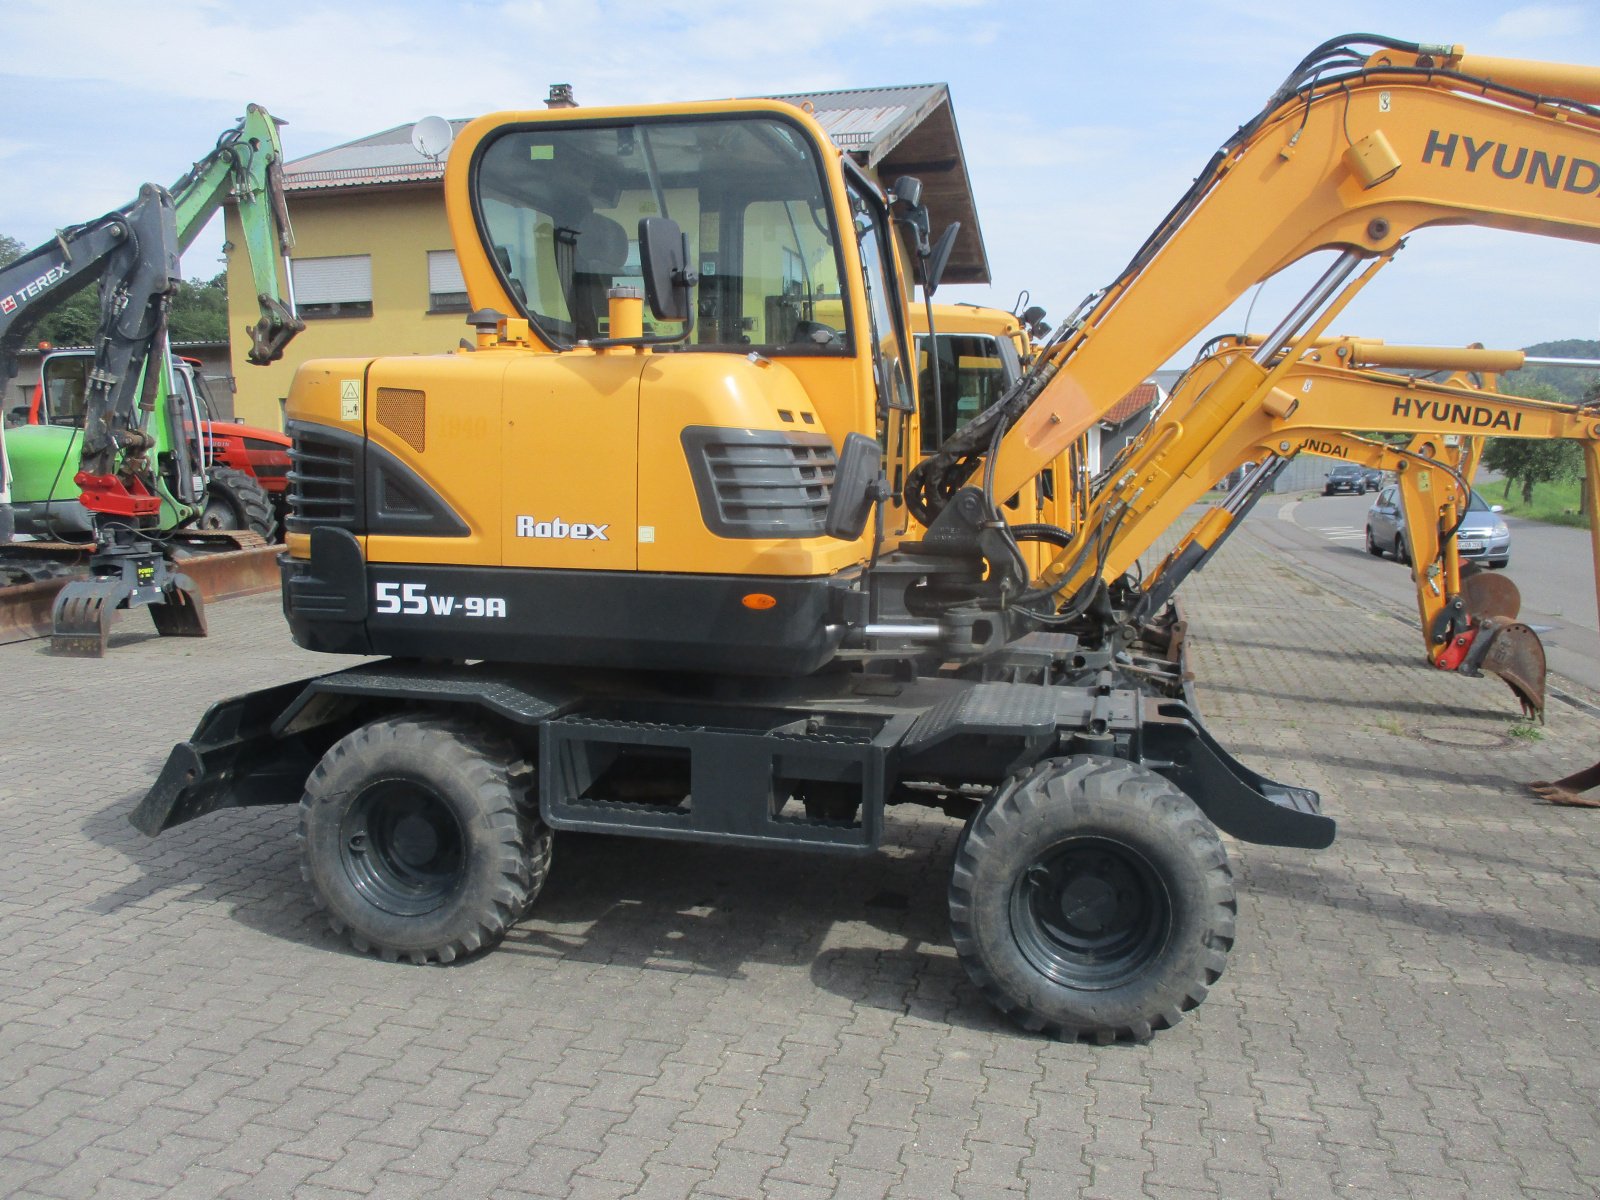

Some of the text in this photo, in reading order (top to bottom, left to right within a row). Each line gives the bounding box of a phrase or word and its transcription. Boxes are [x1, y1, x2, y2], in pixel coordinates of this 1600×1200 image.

[1421, 129, 1600, 197] HYUND
[16, 262, 70, 302] TEREX
[1391, 396, 1523, 432] HYUNDAI
[515, 514, 610, 541] Robex
